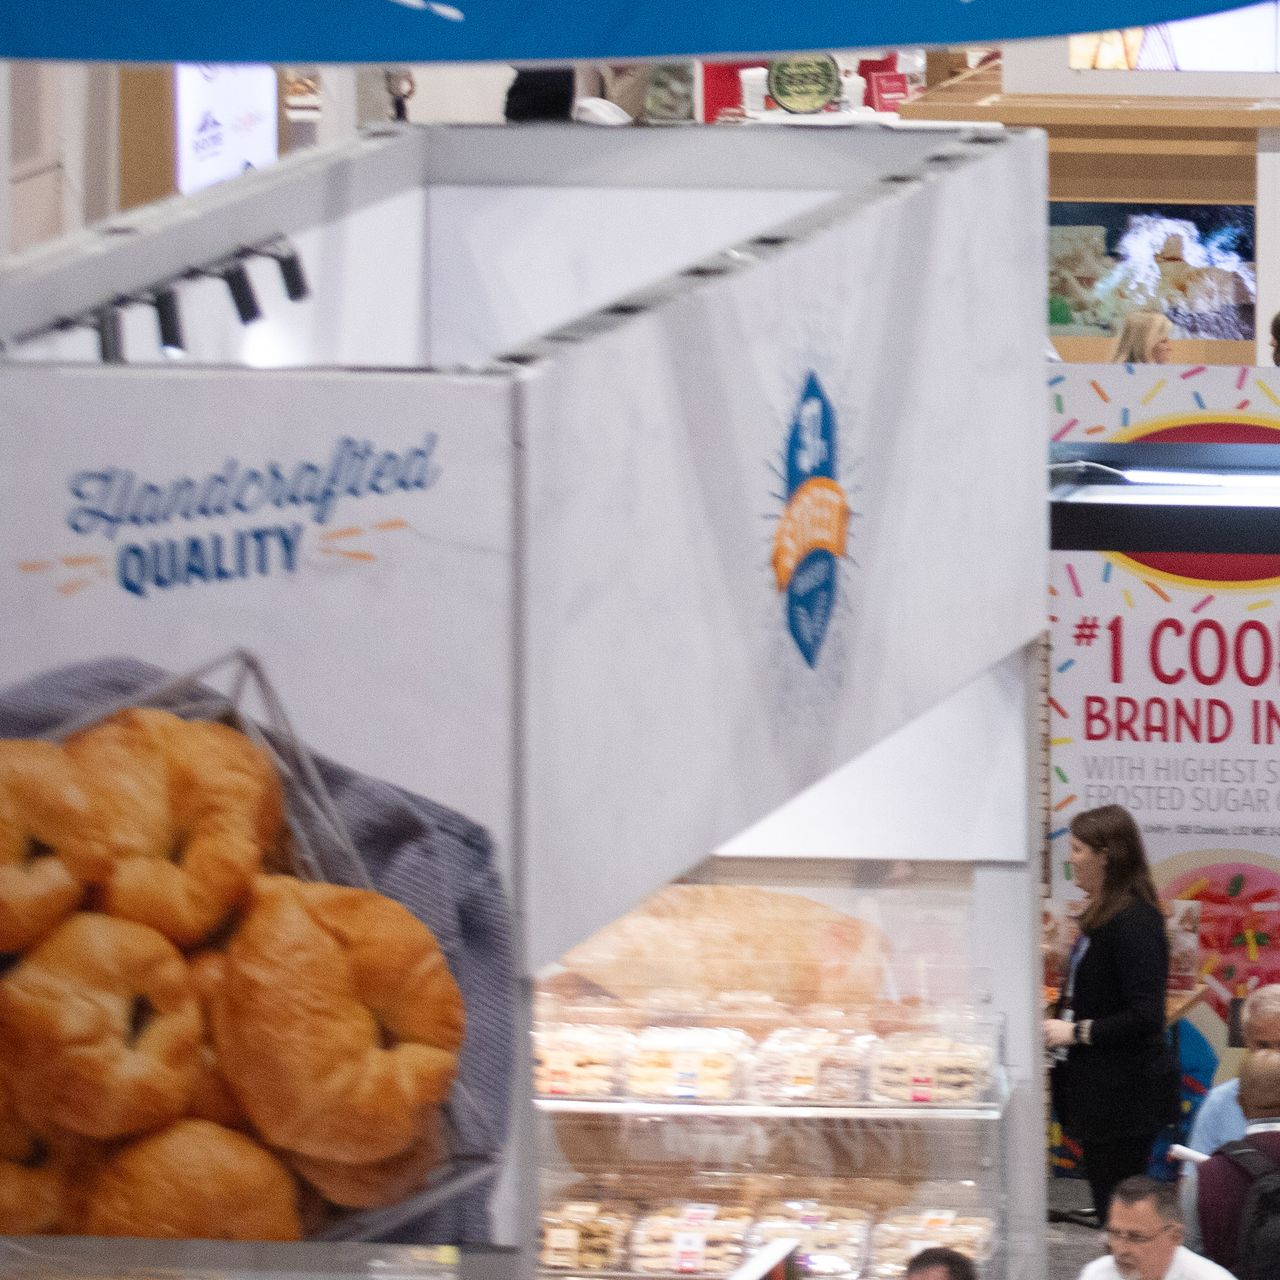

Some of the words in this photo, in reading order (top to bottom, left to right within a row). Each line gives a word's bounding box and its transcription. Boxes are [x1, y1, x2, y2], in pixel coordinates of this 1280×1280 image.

[66, 431, 442, 537] Handcrafted
[116, 524, 306, 598] QUALITY
[1072, 614, 1124, 684] #1
[1084, 695, 1234, 744] BRAND
[1082, 756, 1146, 782] WITH
[1153, 757, 1258, 784] HIGHEST
[1084, 784, 1186, 810] FROSTED
[1191, 787, 1271, 813] SUGAR
